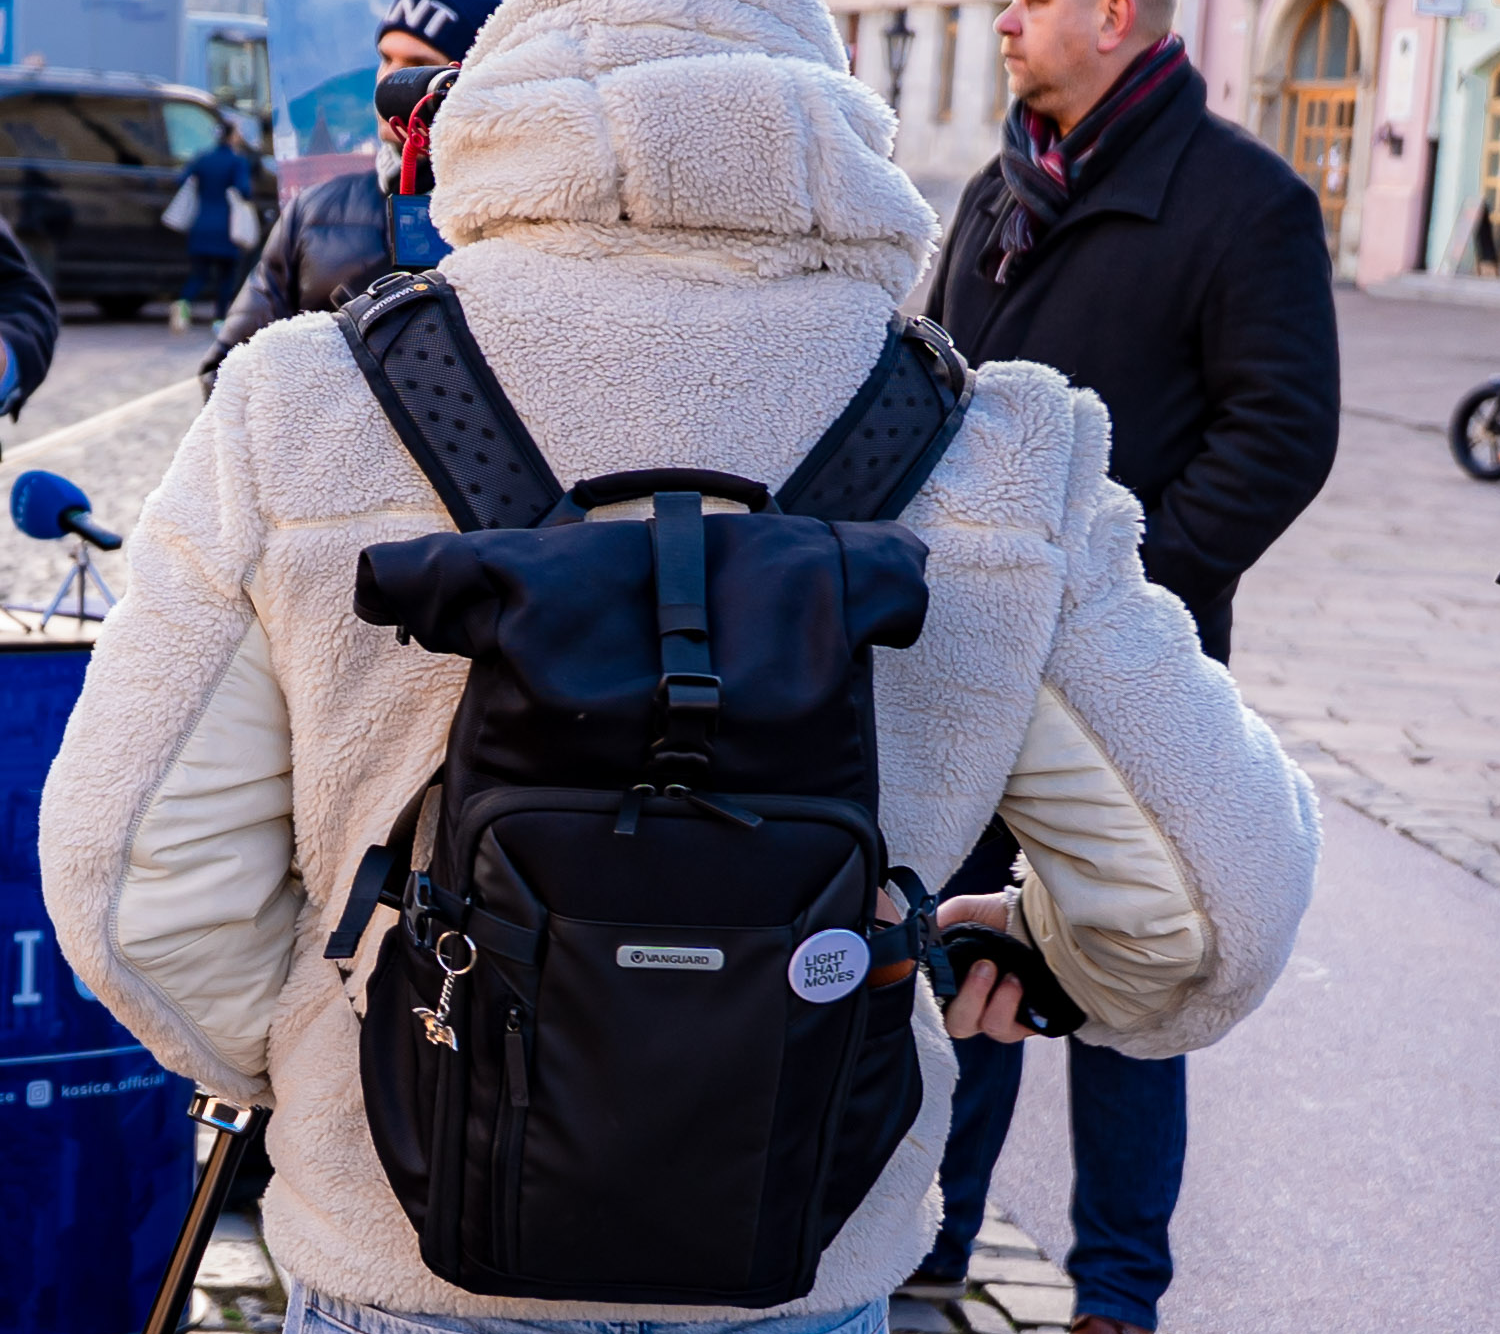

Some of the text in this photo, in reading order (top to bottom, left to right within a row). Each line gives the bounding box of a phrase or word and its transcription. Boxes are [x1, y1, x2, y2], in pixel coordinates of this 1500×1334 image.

[646, 953, 710, 965] VANGUARD
[804, 949, 848, 967] LIGHT
[804, 962, 842, 978] THAT
[804, 970, 855, 988] MOVES
[61, 1073, 166, 1098] kosice_official
